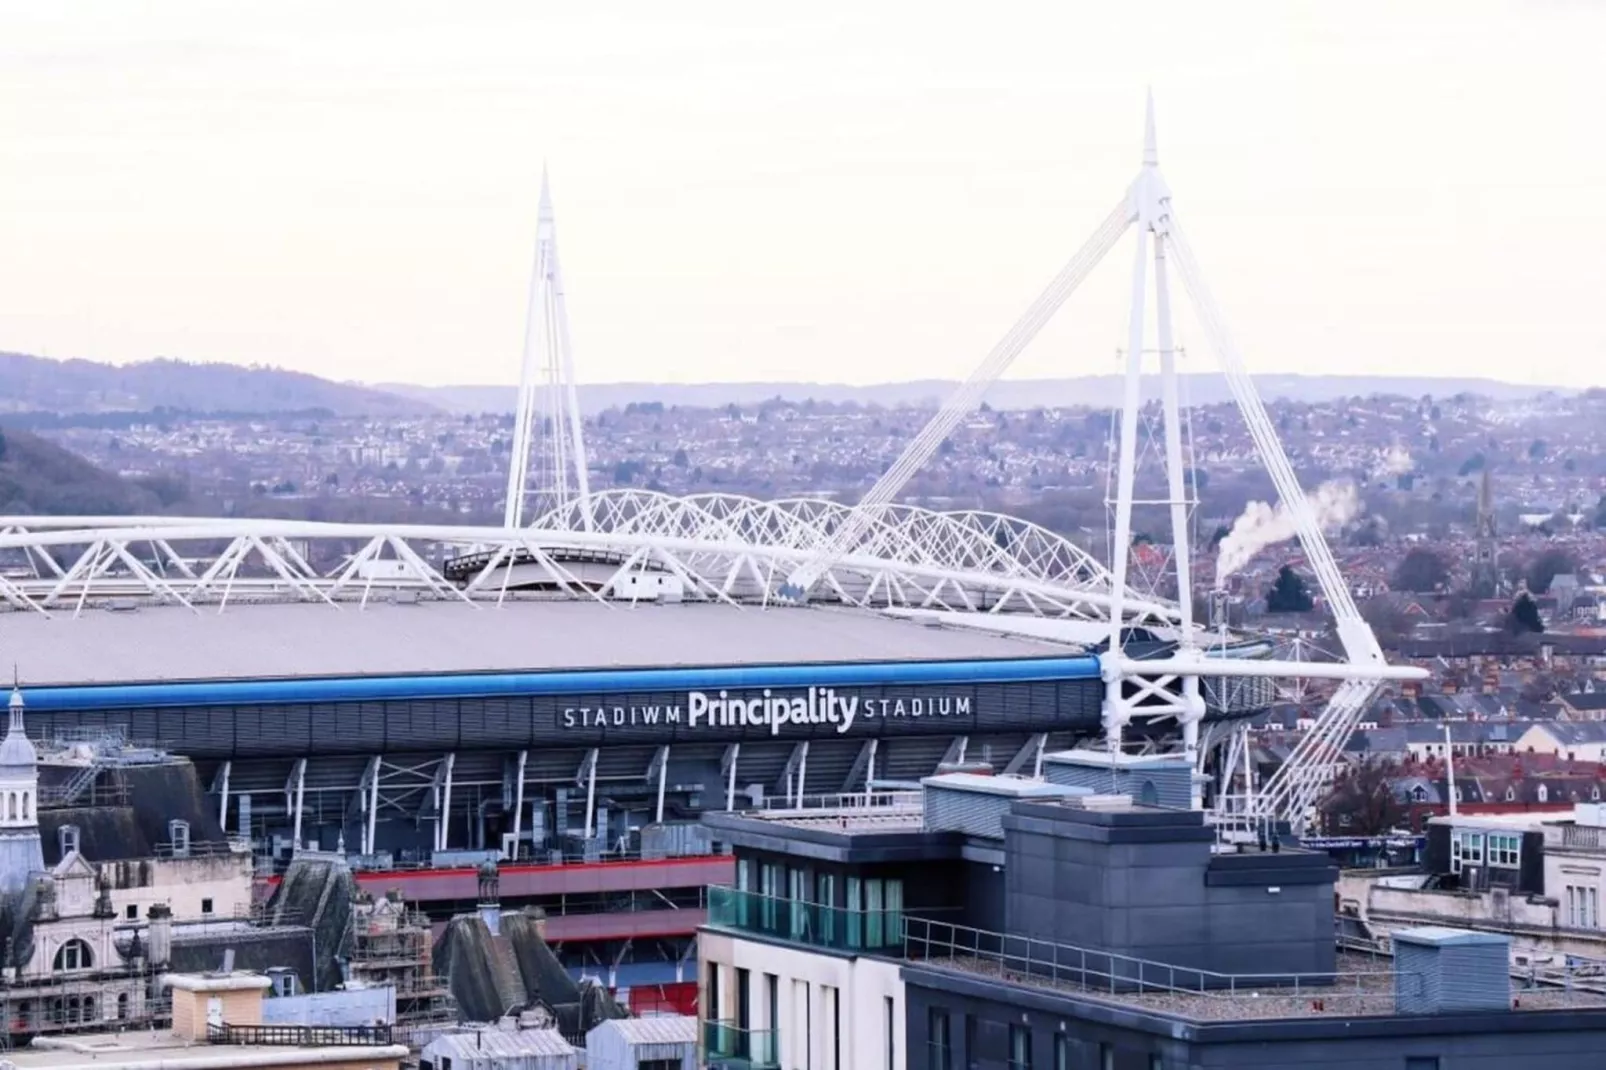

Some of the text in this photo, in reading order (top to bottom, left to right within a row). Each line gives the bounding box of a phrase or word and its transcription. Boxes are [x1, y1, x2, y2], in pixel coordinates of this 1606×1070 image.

[564, 686, 970, 736] STADIWM Principality STADIUM
